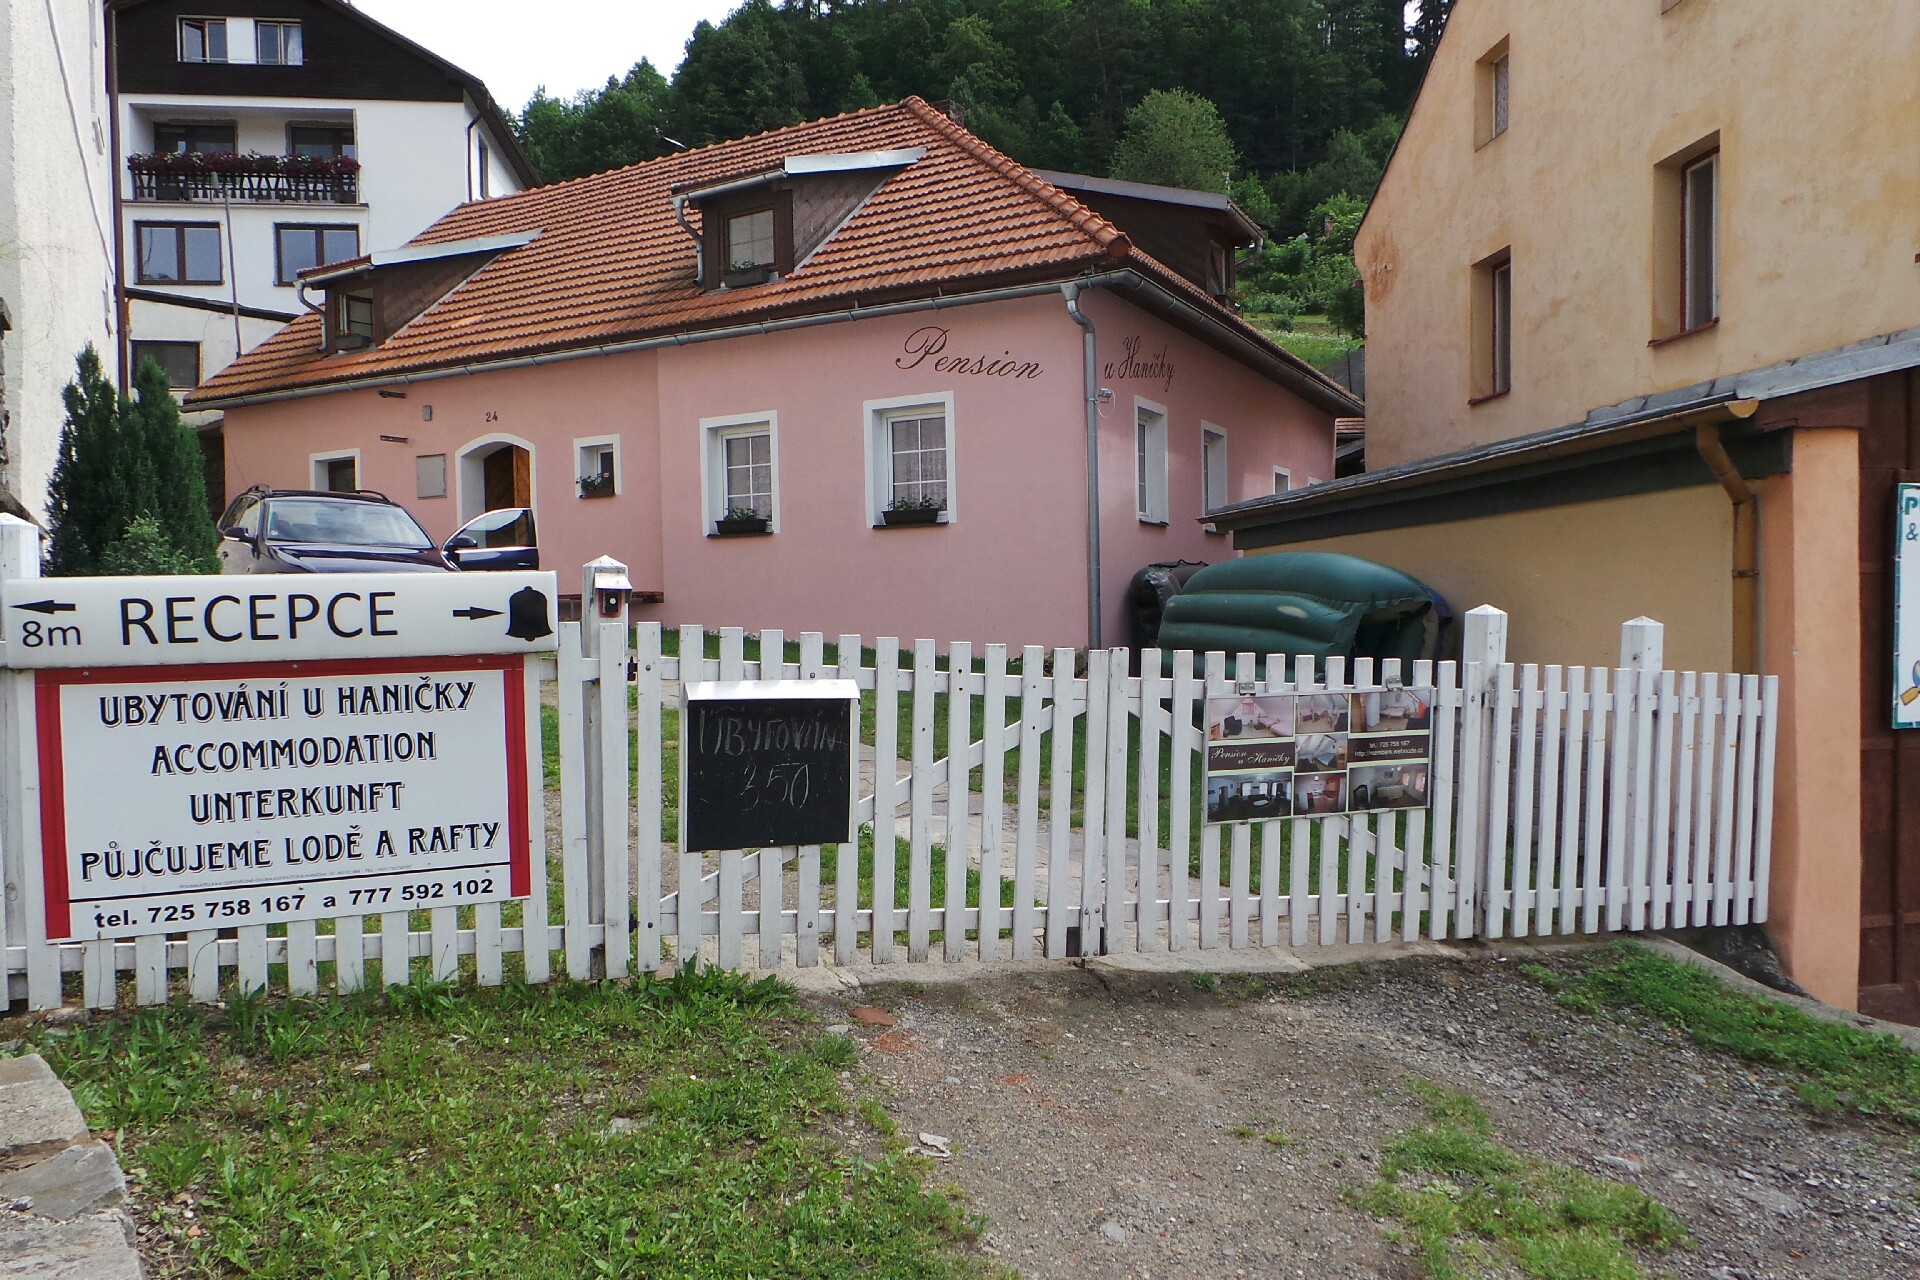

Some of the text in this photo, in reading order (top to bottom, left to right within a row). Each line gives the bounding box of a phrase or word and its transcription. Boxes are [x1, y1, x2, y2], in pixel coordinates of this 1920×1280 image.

[896, 326, 1044, 379] Pension
[1104, 335, 1175, 393] u Haničky
[486, 411, 498, 423] 24
[22, 620, 82, 648] 8m
[120, 591, 399, 646] RECEPCE
[100, 676, 476, 729] UBYTOVÁNÍ U HANIČKY
[151, 731, 437, 776] ACCOMMODATION
[1211, 747, 1247, 760] Pension
[189, 781, 406, 826] UNTERKUNFT
[80, 840, 272, 882] PŮJČUJEME
[285, 825, 364, 866] LODĚ
[375, 830, 398, 857] A
[407, 821, 501, 855] RAFTY
[94, 878, 494, 929] tel. 725 758 167 a 777 592 102
